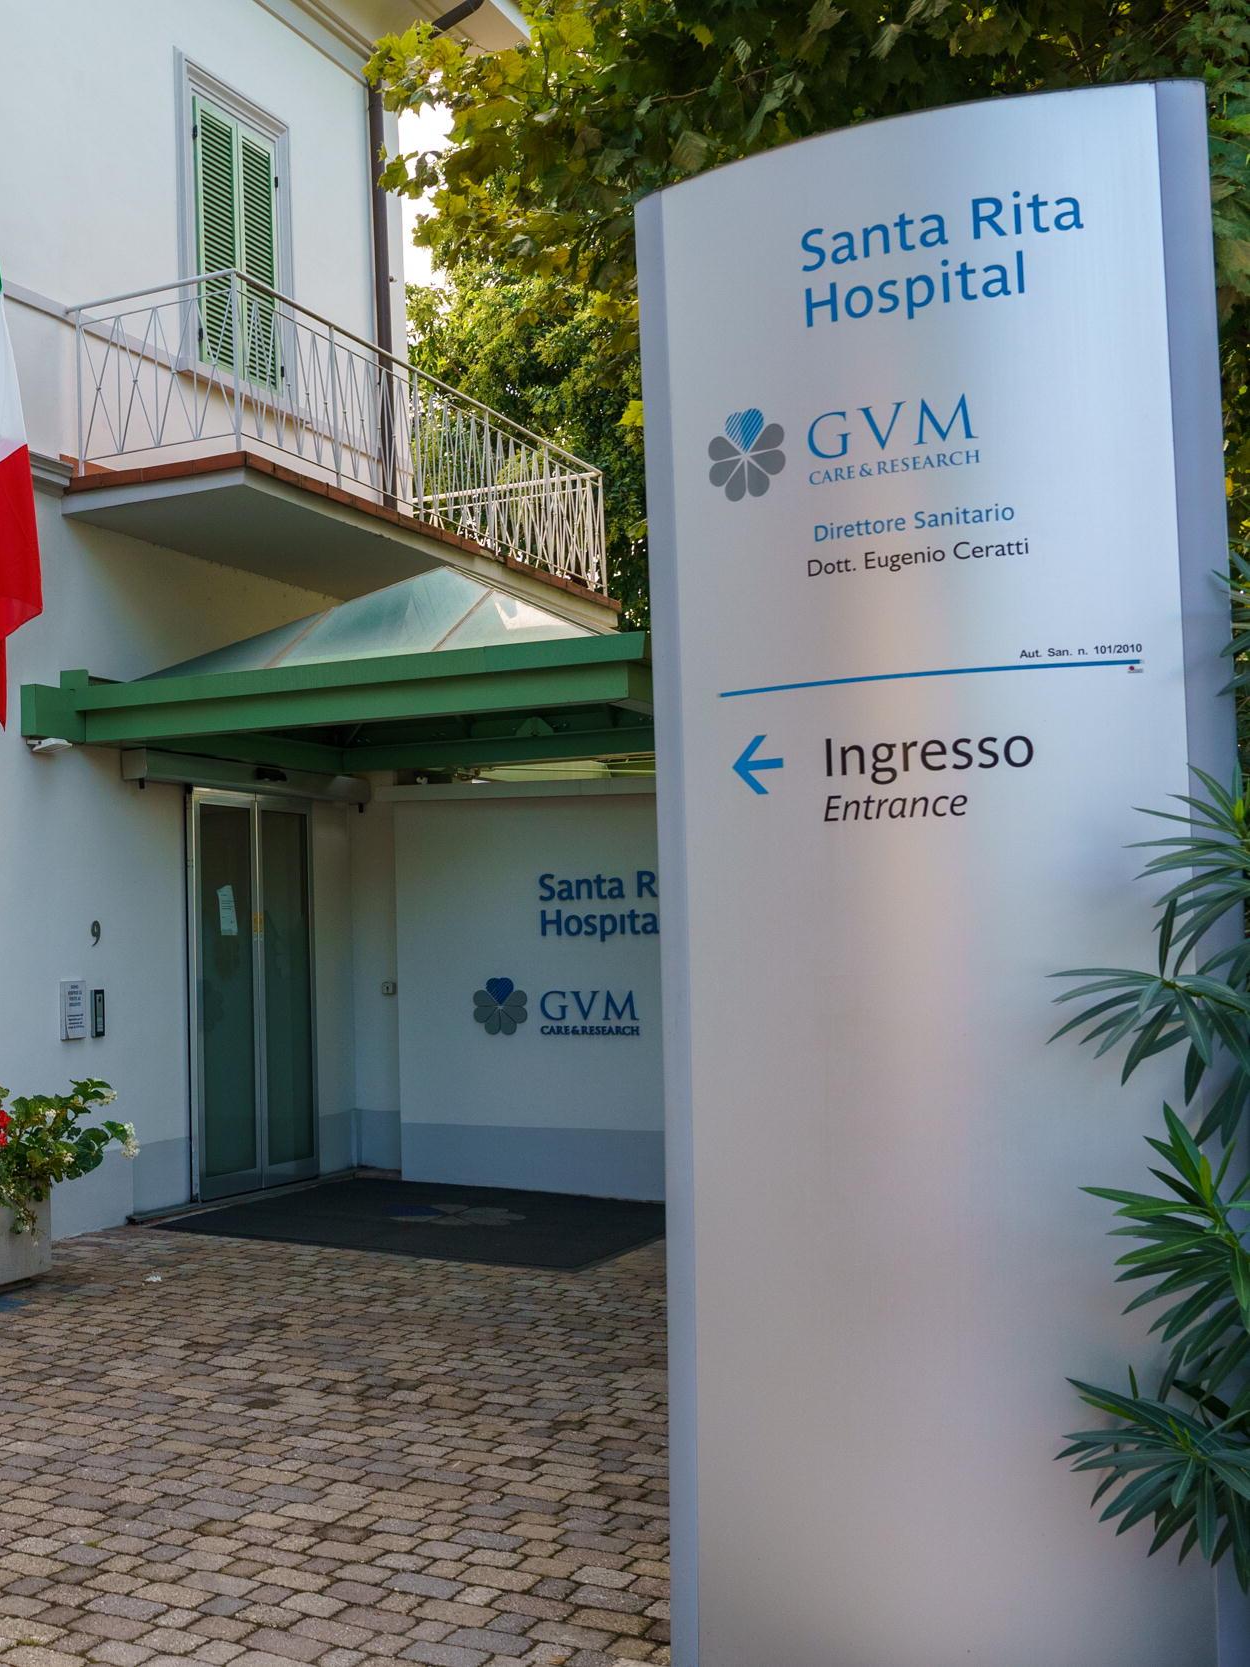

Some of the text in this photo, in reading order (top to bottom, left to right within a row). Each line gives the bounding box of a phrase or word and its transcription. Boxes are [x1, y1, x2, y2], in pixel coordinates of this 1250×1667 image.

[800, 190, 1085, 272] Santa Rita
[803, 250, 1026, 329] Hospital
[806, 392, 980, 461] GVM
[813, 503, 1016, 543] Direttore Sanitario
[807, 537, 1030, 578] Dott. Eugenio Ceratti
[1019, 643, 1143, 659] Aut. San. n. 101/2010
[824, 734, 1035, 786] Ingresso
[823, 794, 969, 823] Entrance
[538, 872, 626, 902] Santa
[90, 919, 102, 948] 9
[540, 908, 660, 943] Hospita
[539, 989, 641, 1022] GVM
